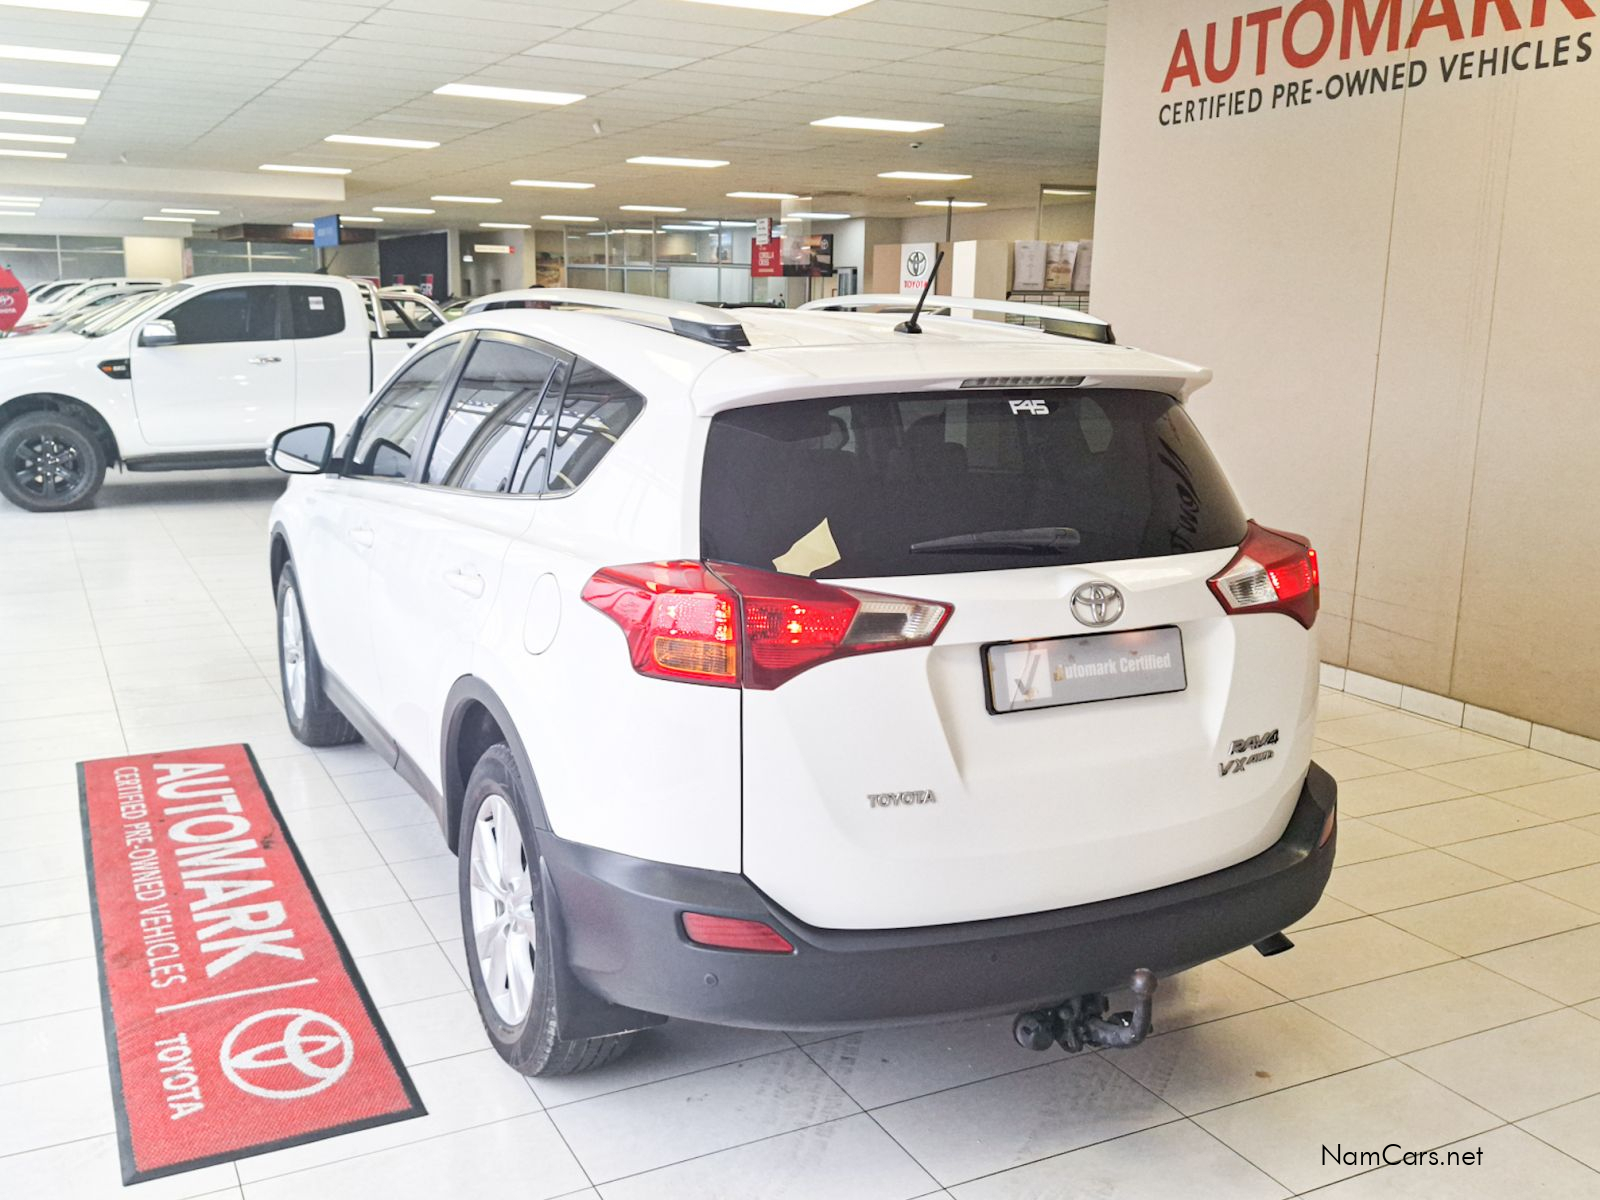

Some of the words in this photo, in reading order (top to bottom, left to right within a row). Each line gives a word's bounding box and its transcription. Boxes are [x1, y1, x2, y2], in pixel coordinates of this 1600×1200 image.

[1159, 87, 1263, 126] CERTIFIED
[1272, 60, 1427, 109] PRE-OWNED
[1440, 31, 1593, 83] VEHICLES
[1119, 651, 1171, 673] Certified
[1219, 757, 1247, 777] VX
[1229, 728, 1279, 755] RAV4
[113, 766, 149, 820] CERTIFIED
[867, 789, 937, 808] TOYOTA
[123, 821, 167, 902] PRE-OWNED
[153, 763, 304, 978] AUTOMARK
[139, 902, 188, 989] VEHICLES
[154, 1032, 205, 1121] TOYOTA
